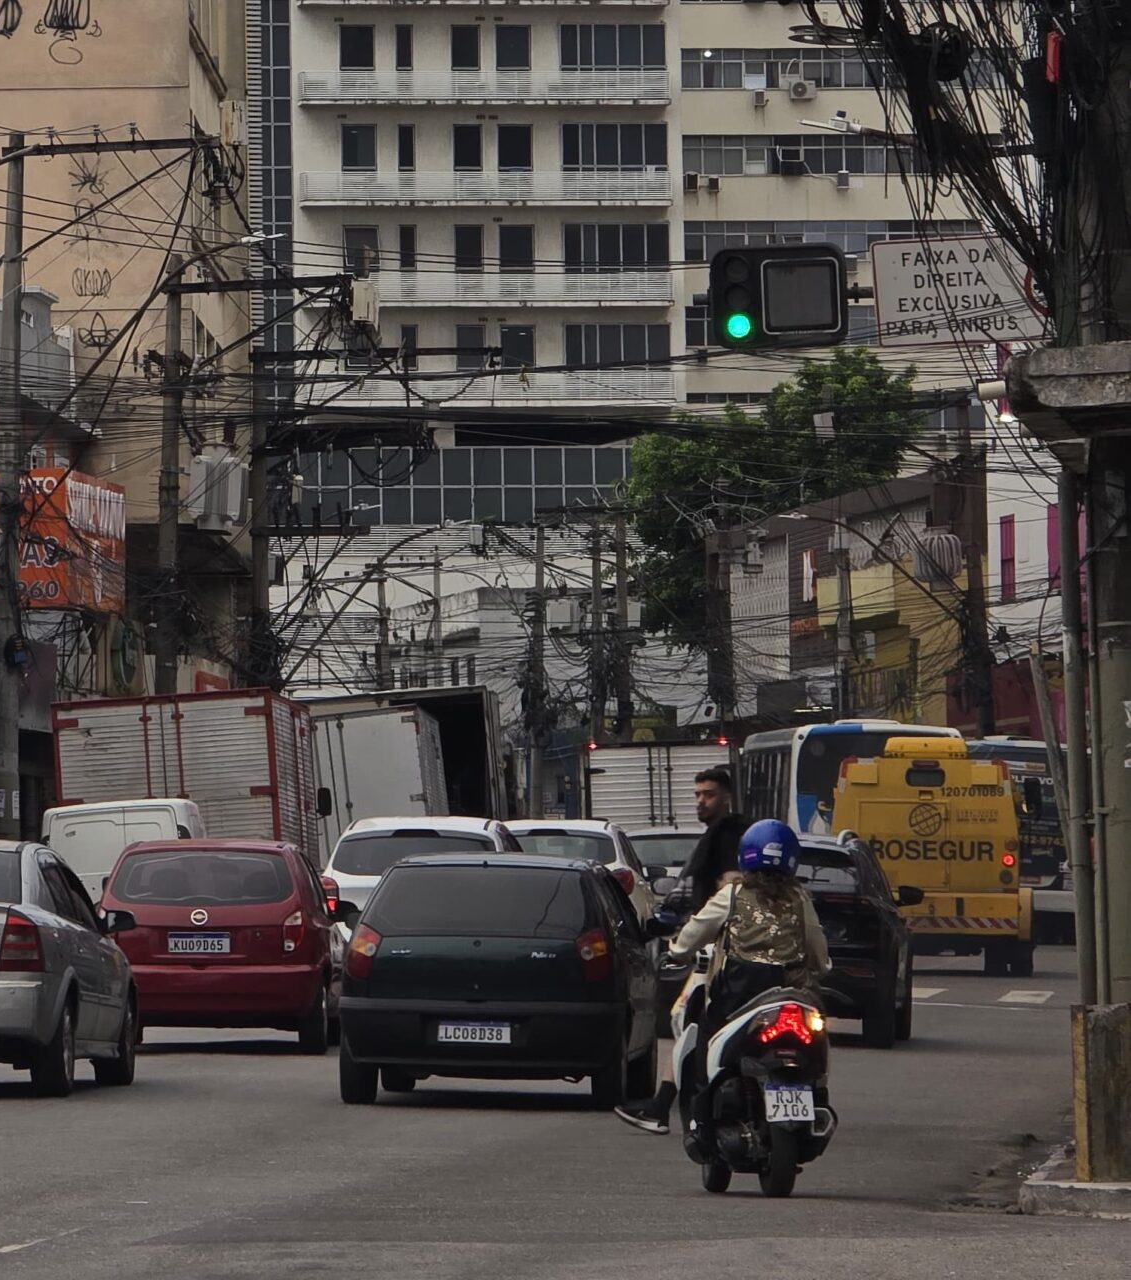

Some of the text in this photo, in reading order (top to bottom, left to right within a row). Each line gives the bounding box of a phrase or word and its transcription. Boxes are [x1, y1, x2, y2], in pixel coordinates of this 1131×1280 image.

[901, 248, 995, 268] FAIXA DA
[913, 271, 987, 289] DIREITA
[898, 293, 1003, 313] EXCLUSIVA
[886, 312, 1019, 336] PARA ÔNIBUS
[871, 839, 995, 862] ROSEGUR
[775, 1091, 804, 1104] RJK
